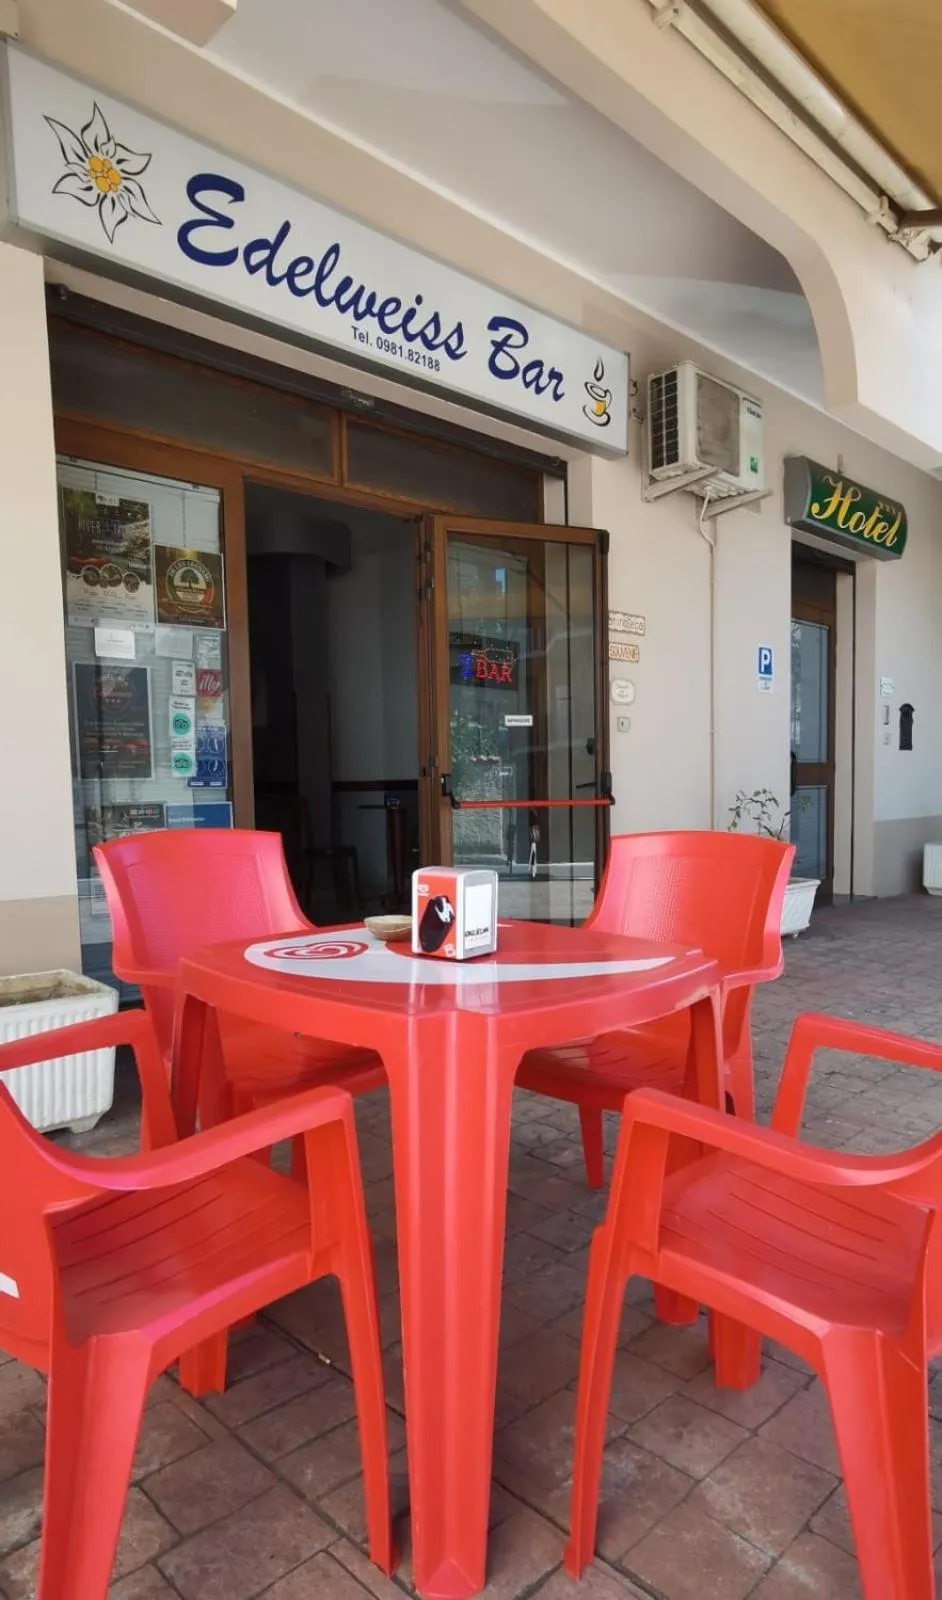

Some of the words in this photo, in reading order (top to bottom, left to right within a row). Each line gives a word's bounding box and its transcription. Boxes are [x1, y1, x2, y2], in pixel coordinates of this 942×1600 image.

[177, 173, 467, 360] Edelweiss
[487, 316, 565, 402] Bar
[351, 325, 373, 346] Tel.
[376, 336, 440, 371] 0981.82188
[811, 476, 902, 547] Hotel
[476, 657, 513, 684] BAR
[760, 649, 770, 673] P
